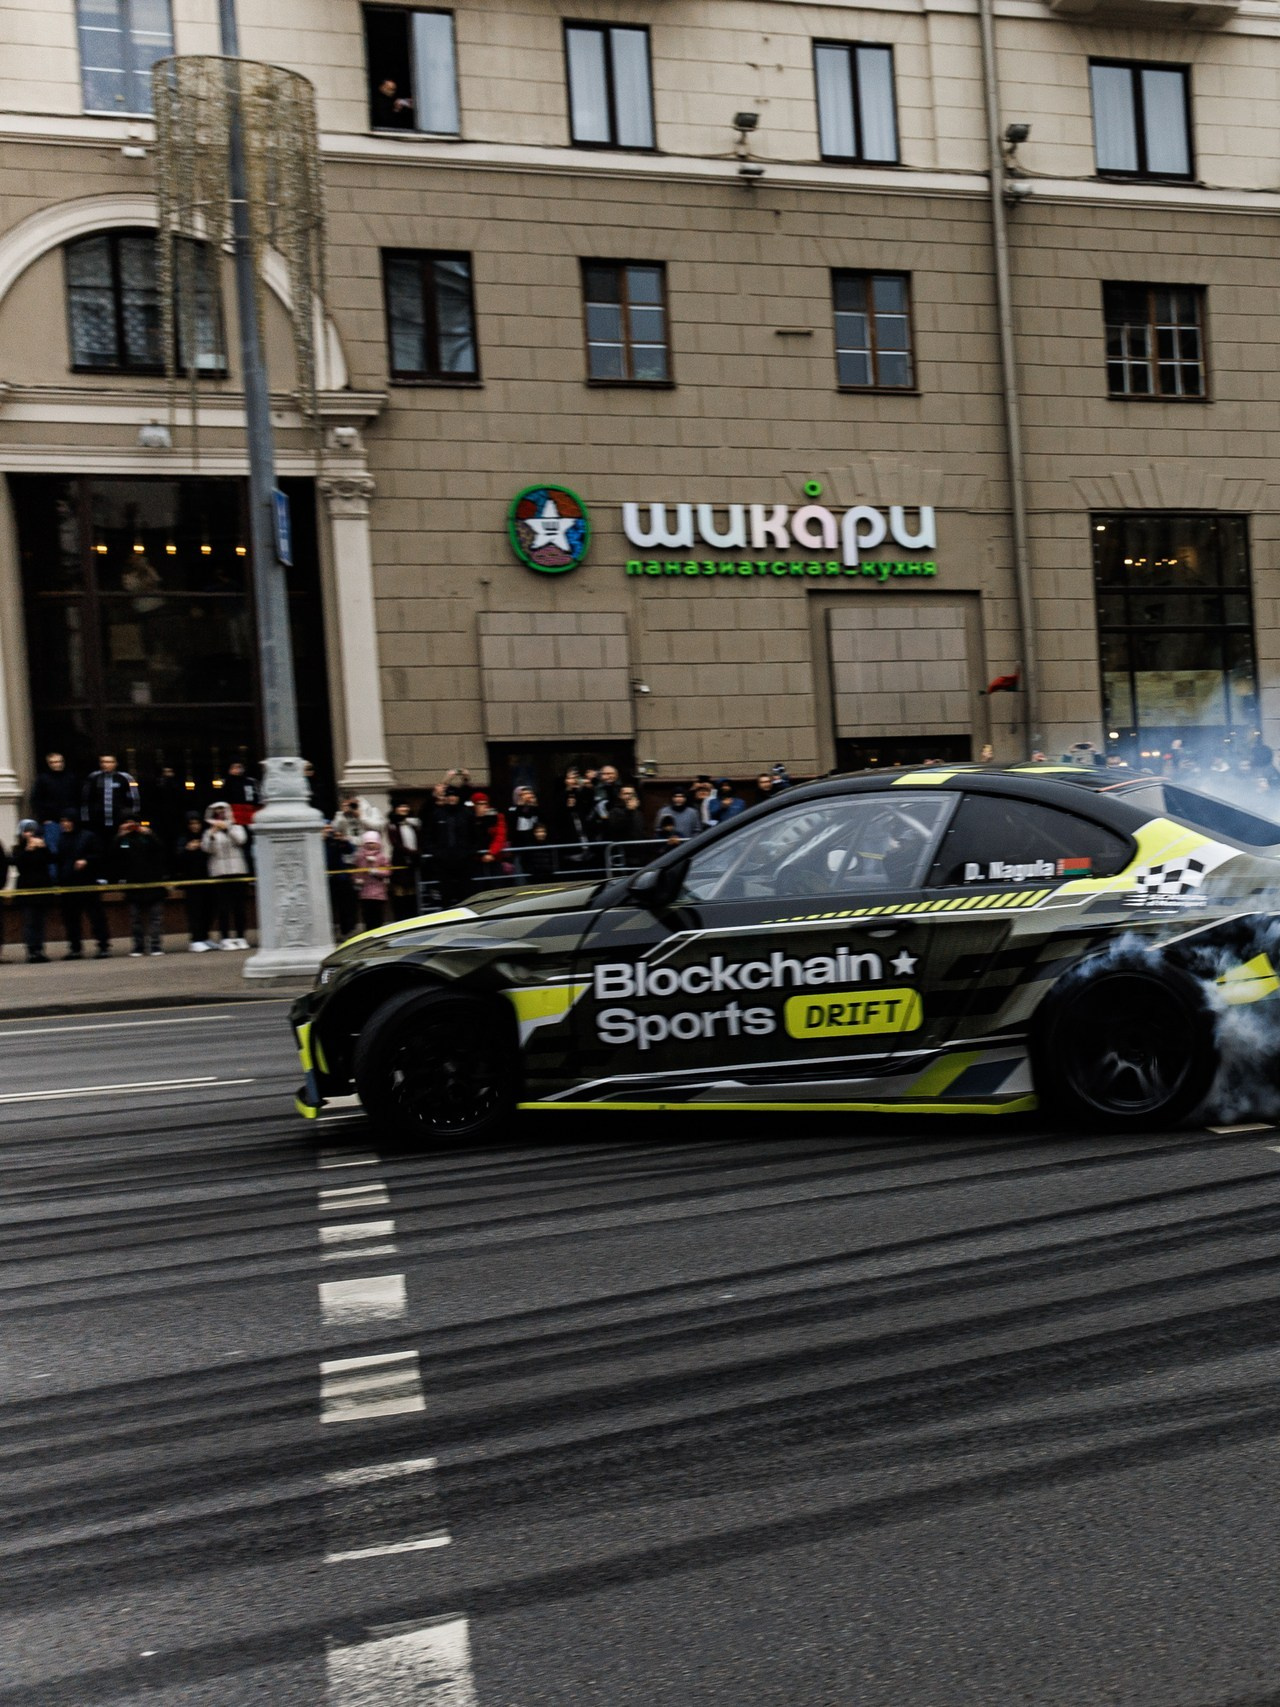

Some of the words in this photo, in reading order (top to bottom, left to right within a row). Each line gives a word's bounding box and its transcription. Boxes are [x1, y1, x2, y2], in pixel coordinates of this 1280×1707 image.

[622, 502, 936, 566] шикари
[626, 560, 840, 575] паназиатская
[861, 561, 936, 581] кухня
[965, 862, 985, 880] D.
[594, 946, 883, 999] Blockchain
[596, 1001, 776, 1050] Sports
[805, 999, 902, 1029] DRIFT
